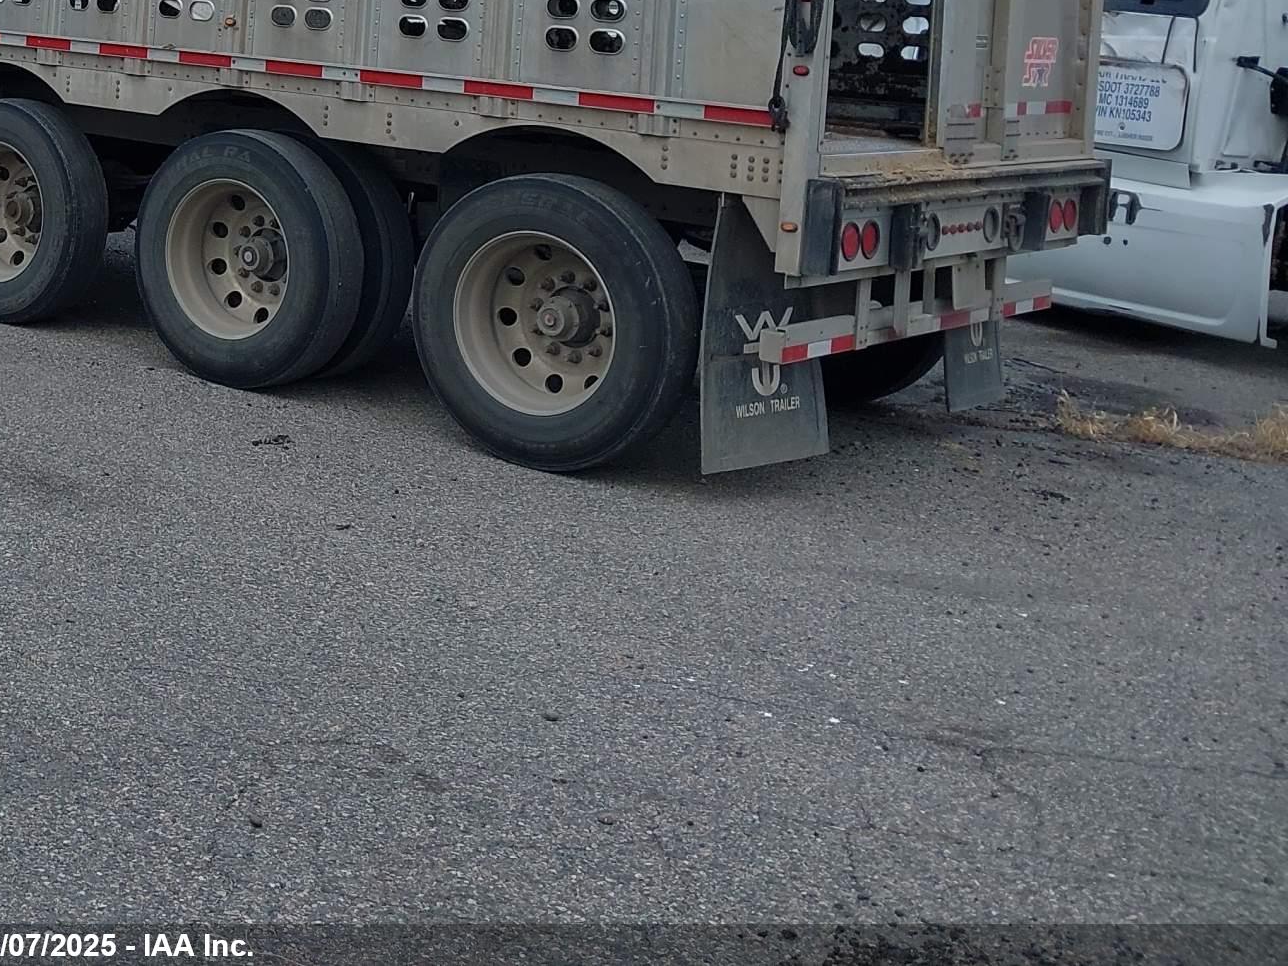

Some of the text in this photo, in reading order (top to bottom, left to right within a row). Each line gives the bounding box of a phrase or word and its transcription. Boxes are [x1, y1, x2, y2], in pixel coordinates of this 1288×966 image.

[1098, 80, 1122, 93] SDOT
[1099, 93, 1112, 105] MC
[735, 396, 801, 418] WILSON TRAILER
